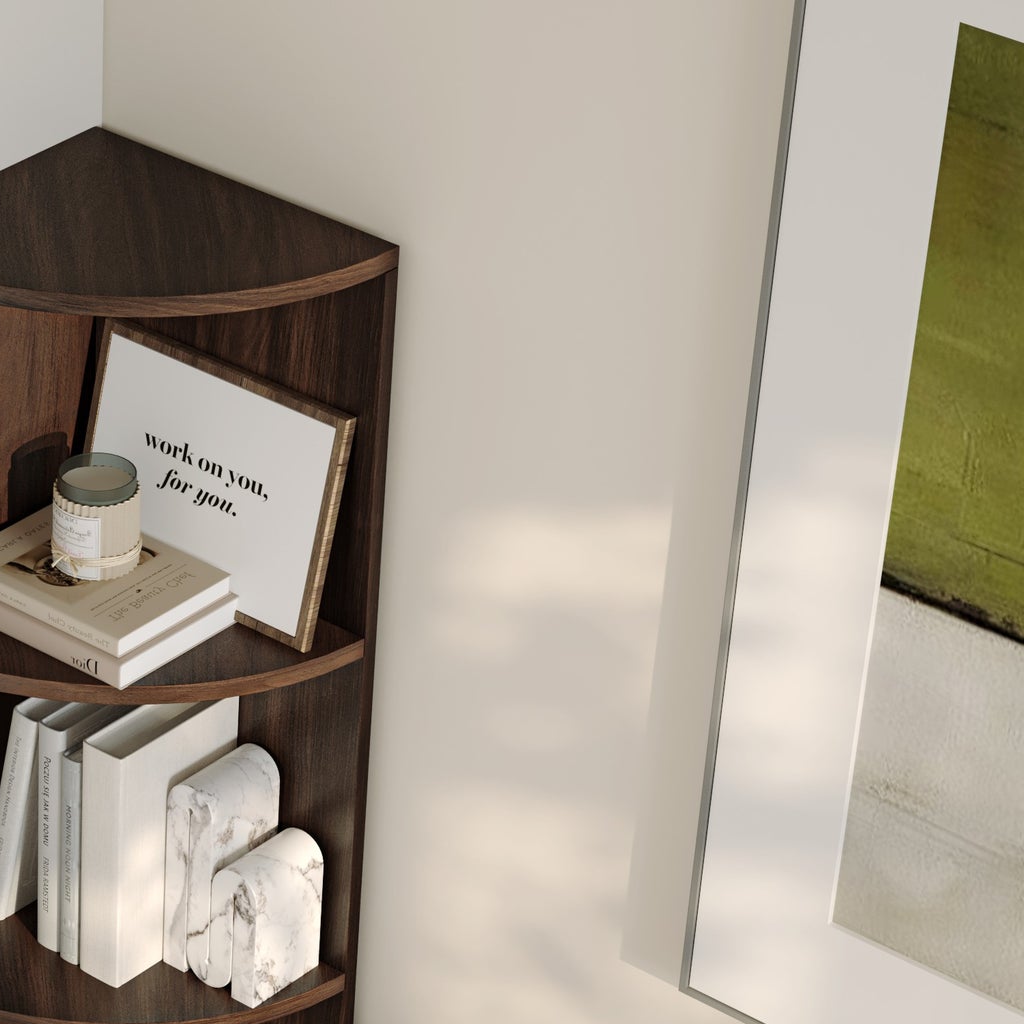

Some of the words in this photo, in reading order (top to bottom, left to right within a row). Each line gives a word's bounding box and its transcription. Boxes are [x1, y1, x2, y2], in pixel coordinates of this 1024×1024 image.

[144, 432, 194, 466] work
[198, 457, 223, 478] on
[225, 469, 269, 502] you,
[156, 469, 193, 493] for
[193, 488, 237, 517] you.
[42, 813, 50, 822] W
[64, 804, 72, 846] MORNING
[42, 822, 50, 847] DOMU
[64, 847, 72, 874] NOON
[64, 874, 72, 903] NIGHT
